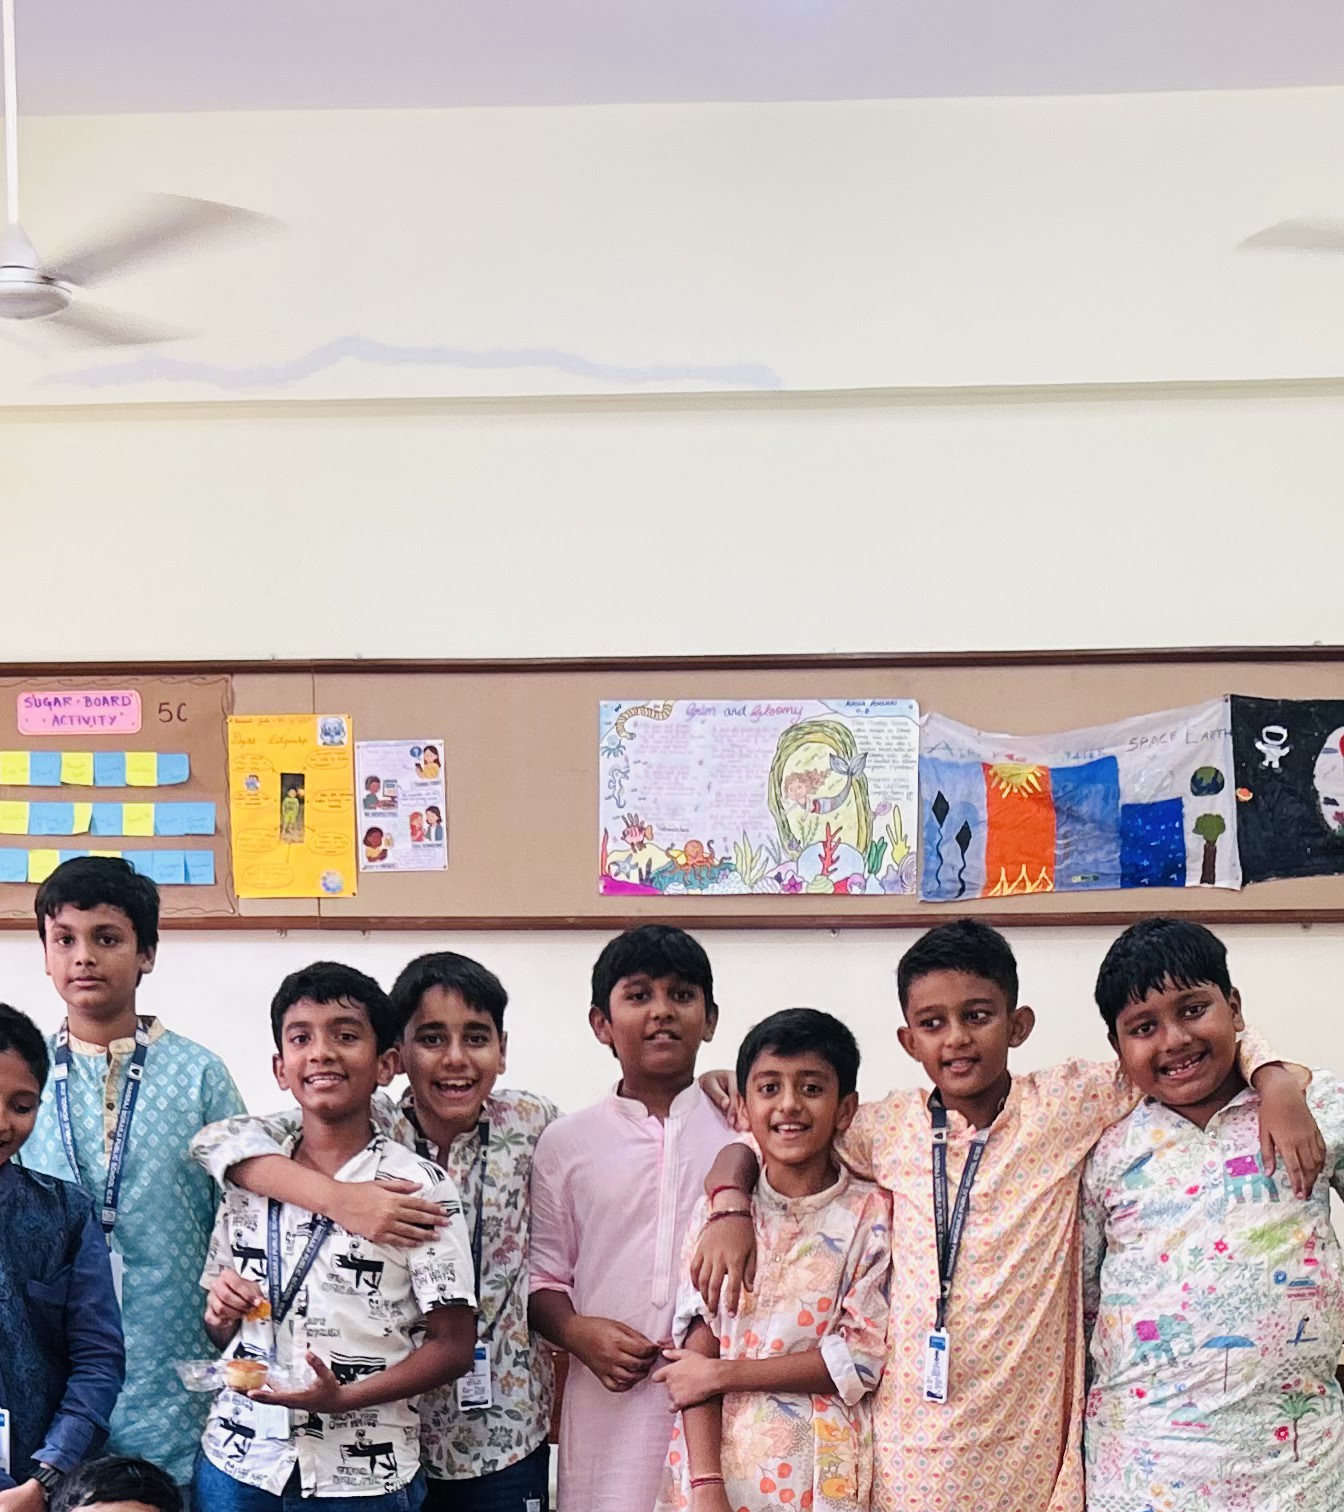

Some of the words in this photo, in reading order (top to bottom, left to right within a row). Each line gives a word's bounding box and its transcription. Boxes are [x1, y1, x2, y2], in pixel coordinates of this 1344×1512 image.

[24, 696, 72, 711] SUGAR
[85, 695, 132, 708] BOARD
[724, 705, 746, 717] and
[52, 714, 117, 727] ACTIVITY
[1127, 731, 1178, 752] SPACE
